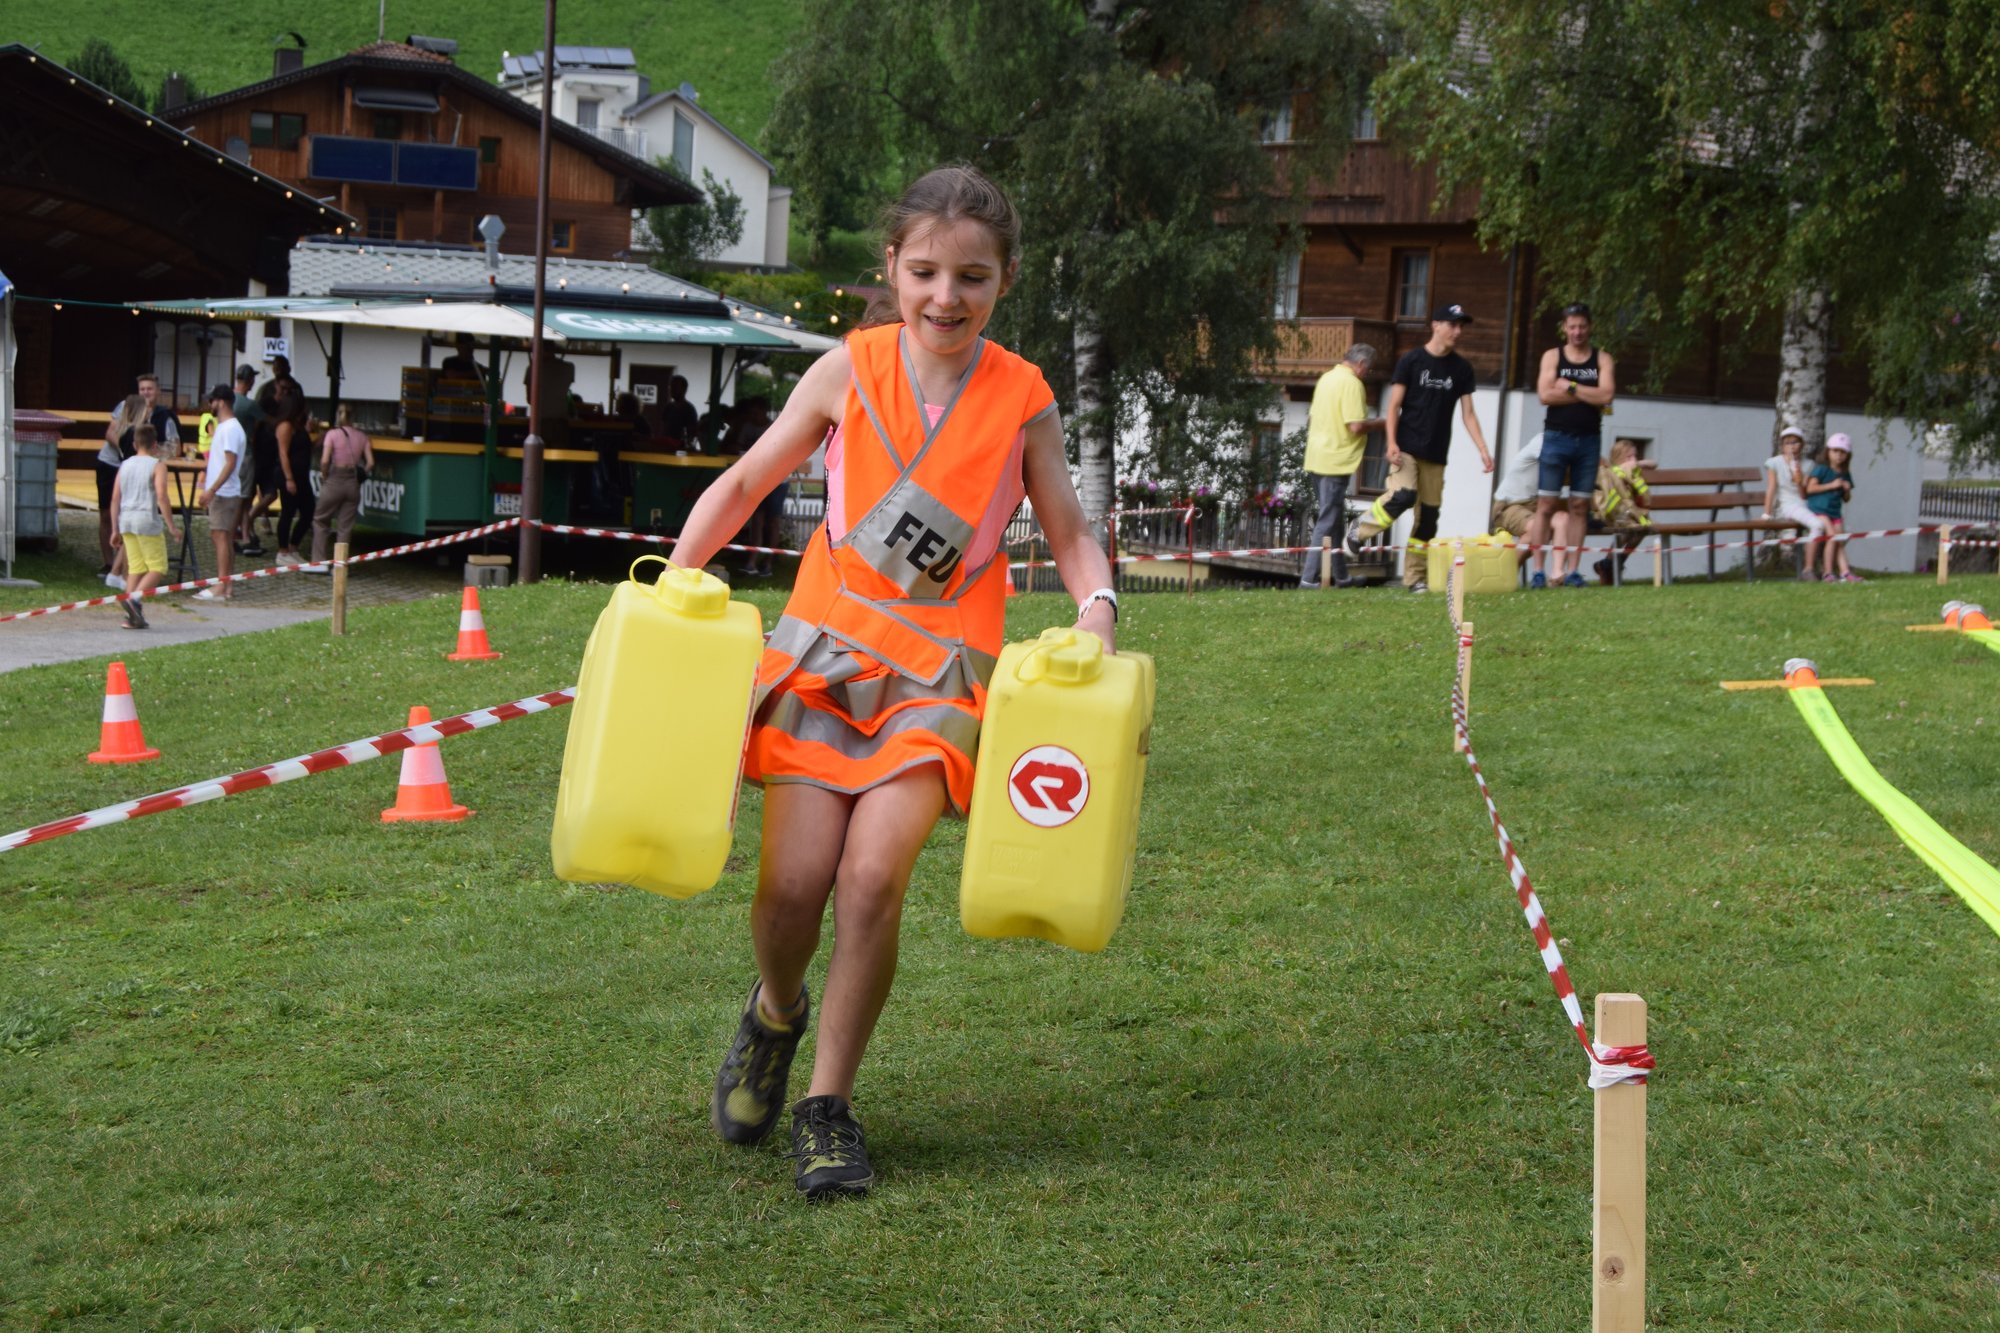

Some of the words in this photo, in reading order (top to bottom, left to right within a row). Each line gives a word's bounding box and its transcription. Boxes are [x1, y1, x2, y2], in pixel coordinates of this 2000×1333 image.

[555, 313, 735, 336] Gösser
[266, 340, 286, 351] WC
[636, 385, 655, 397] WC
